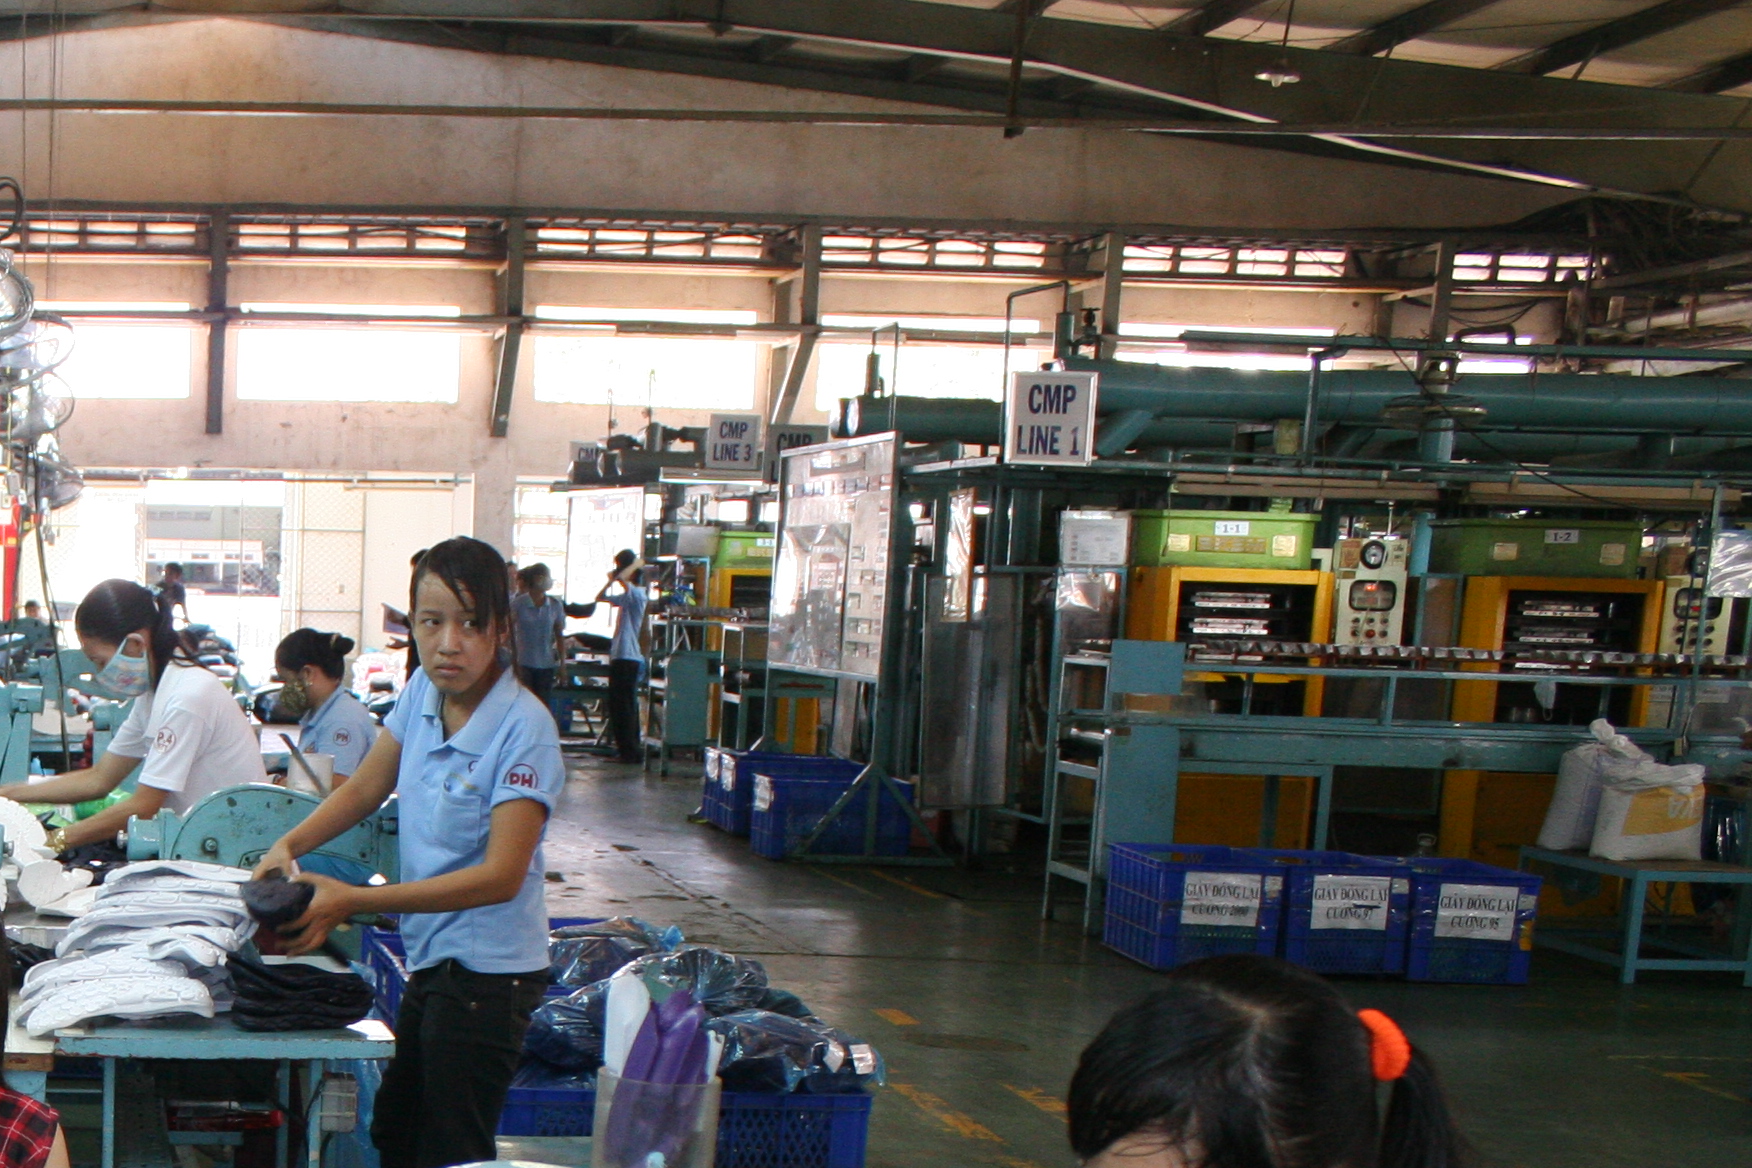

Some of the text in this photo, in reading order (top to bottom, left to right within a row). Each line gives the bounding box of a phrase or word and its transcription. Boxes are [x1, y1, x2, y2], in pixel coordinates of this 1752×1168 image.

[1028, 384, 1077, 415] CMP
[719, 421, 748, 439] CMP
[1016, 425, 1080, 456] LINE 1
[713, 443, 752, 462] LINE 3
[1222, 523, 1241, 534] 1-1
